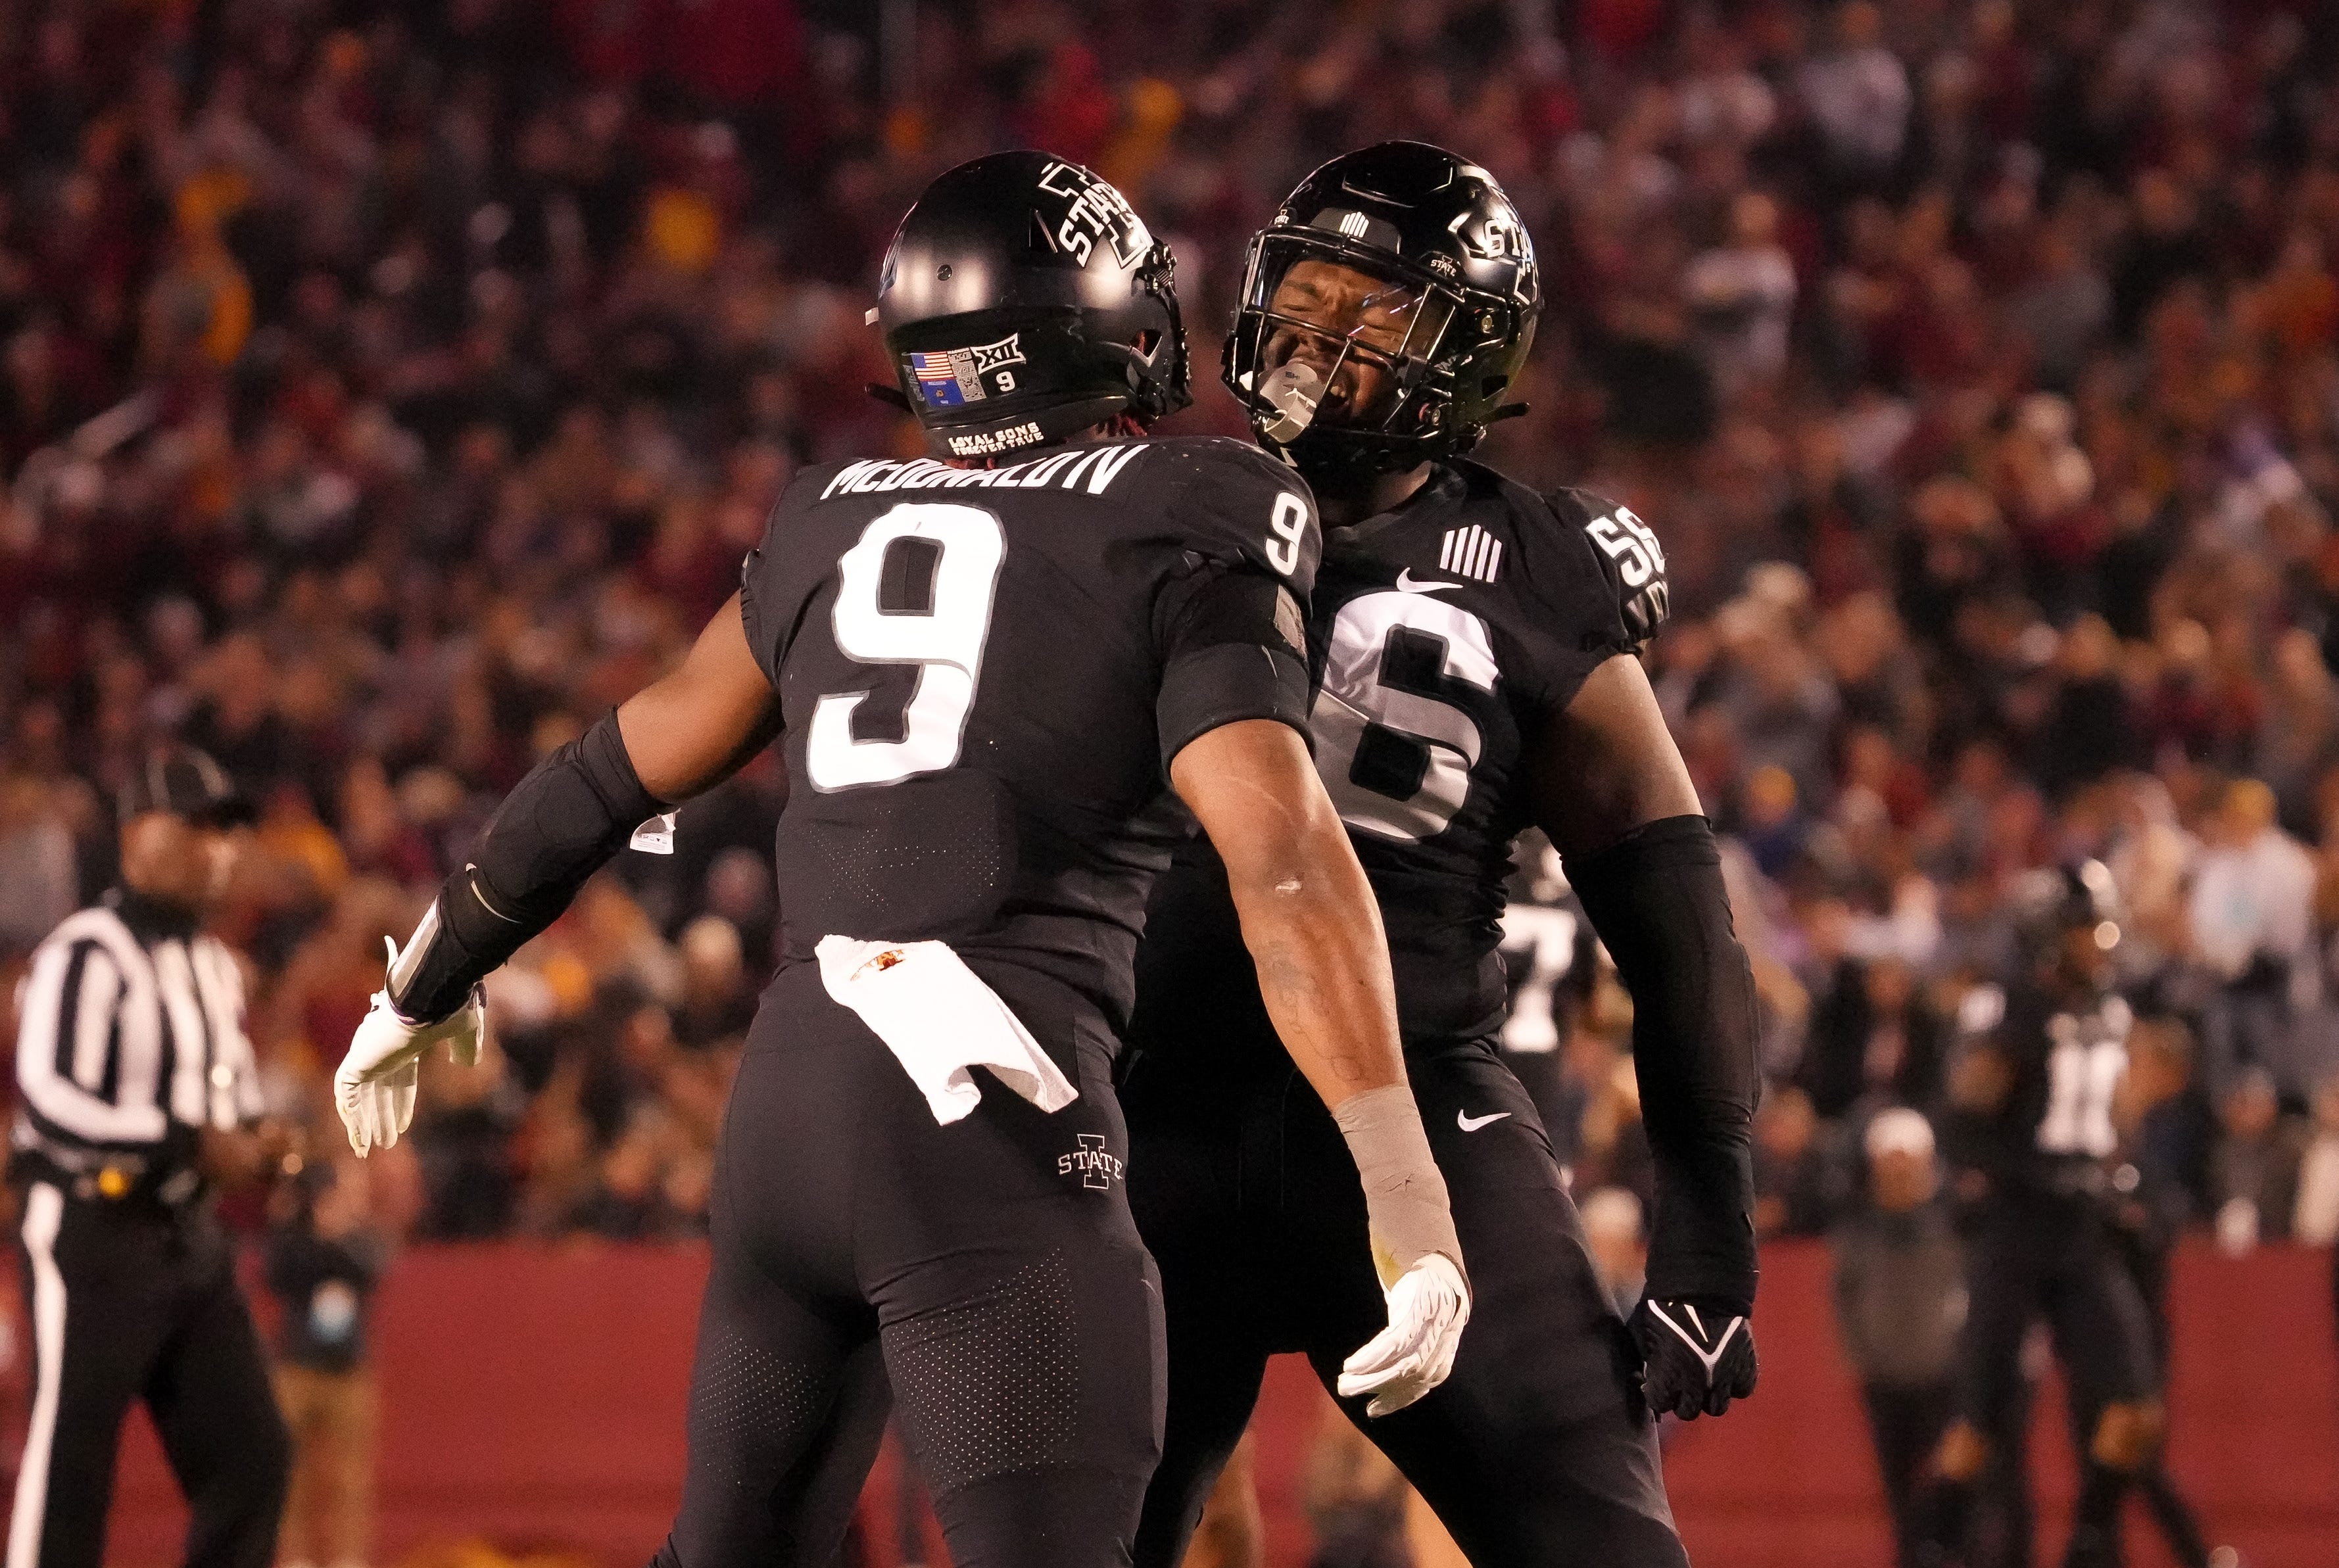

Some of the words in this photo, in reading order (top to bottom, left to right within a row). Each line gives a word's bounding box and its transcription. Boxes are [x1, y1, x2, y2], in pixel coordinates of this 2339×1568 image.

[1430, 259, 1457, 277] STATE
[975, 342, 1018, 371] XII
[996, 370, 1015, 392] 9
[948, 433, 994, 448] LOYAL
[995, 421, 1040, 442] SONS
[953, 441, 1006, 456] FOREVER
[1006, 431, 1044, 448] TRUE
[1061, 444, 1150, 494] IV
[1265, 492, 1308, 576] 9
[1585, 505, 1666, 587] 56
[807, 502, 1006, 792] 9
[1057, 1151, 1123, 1180] STATE
